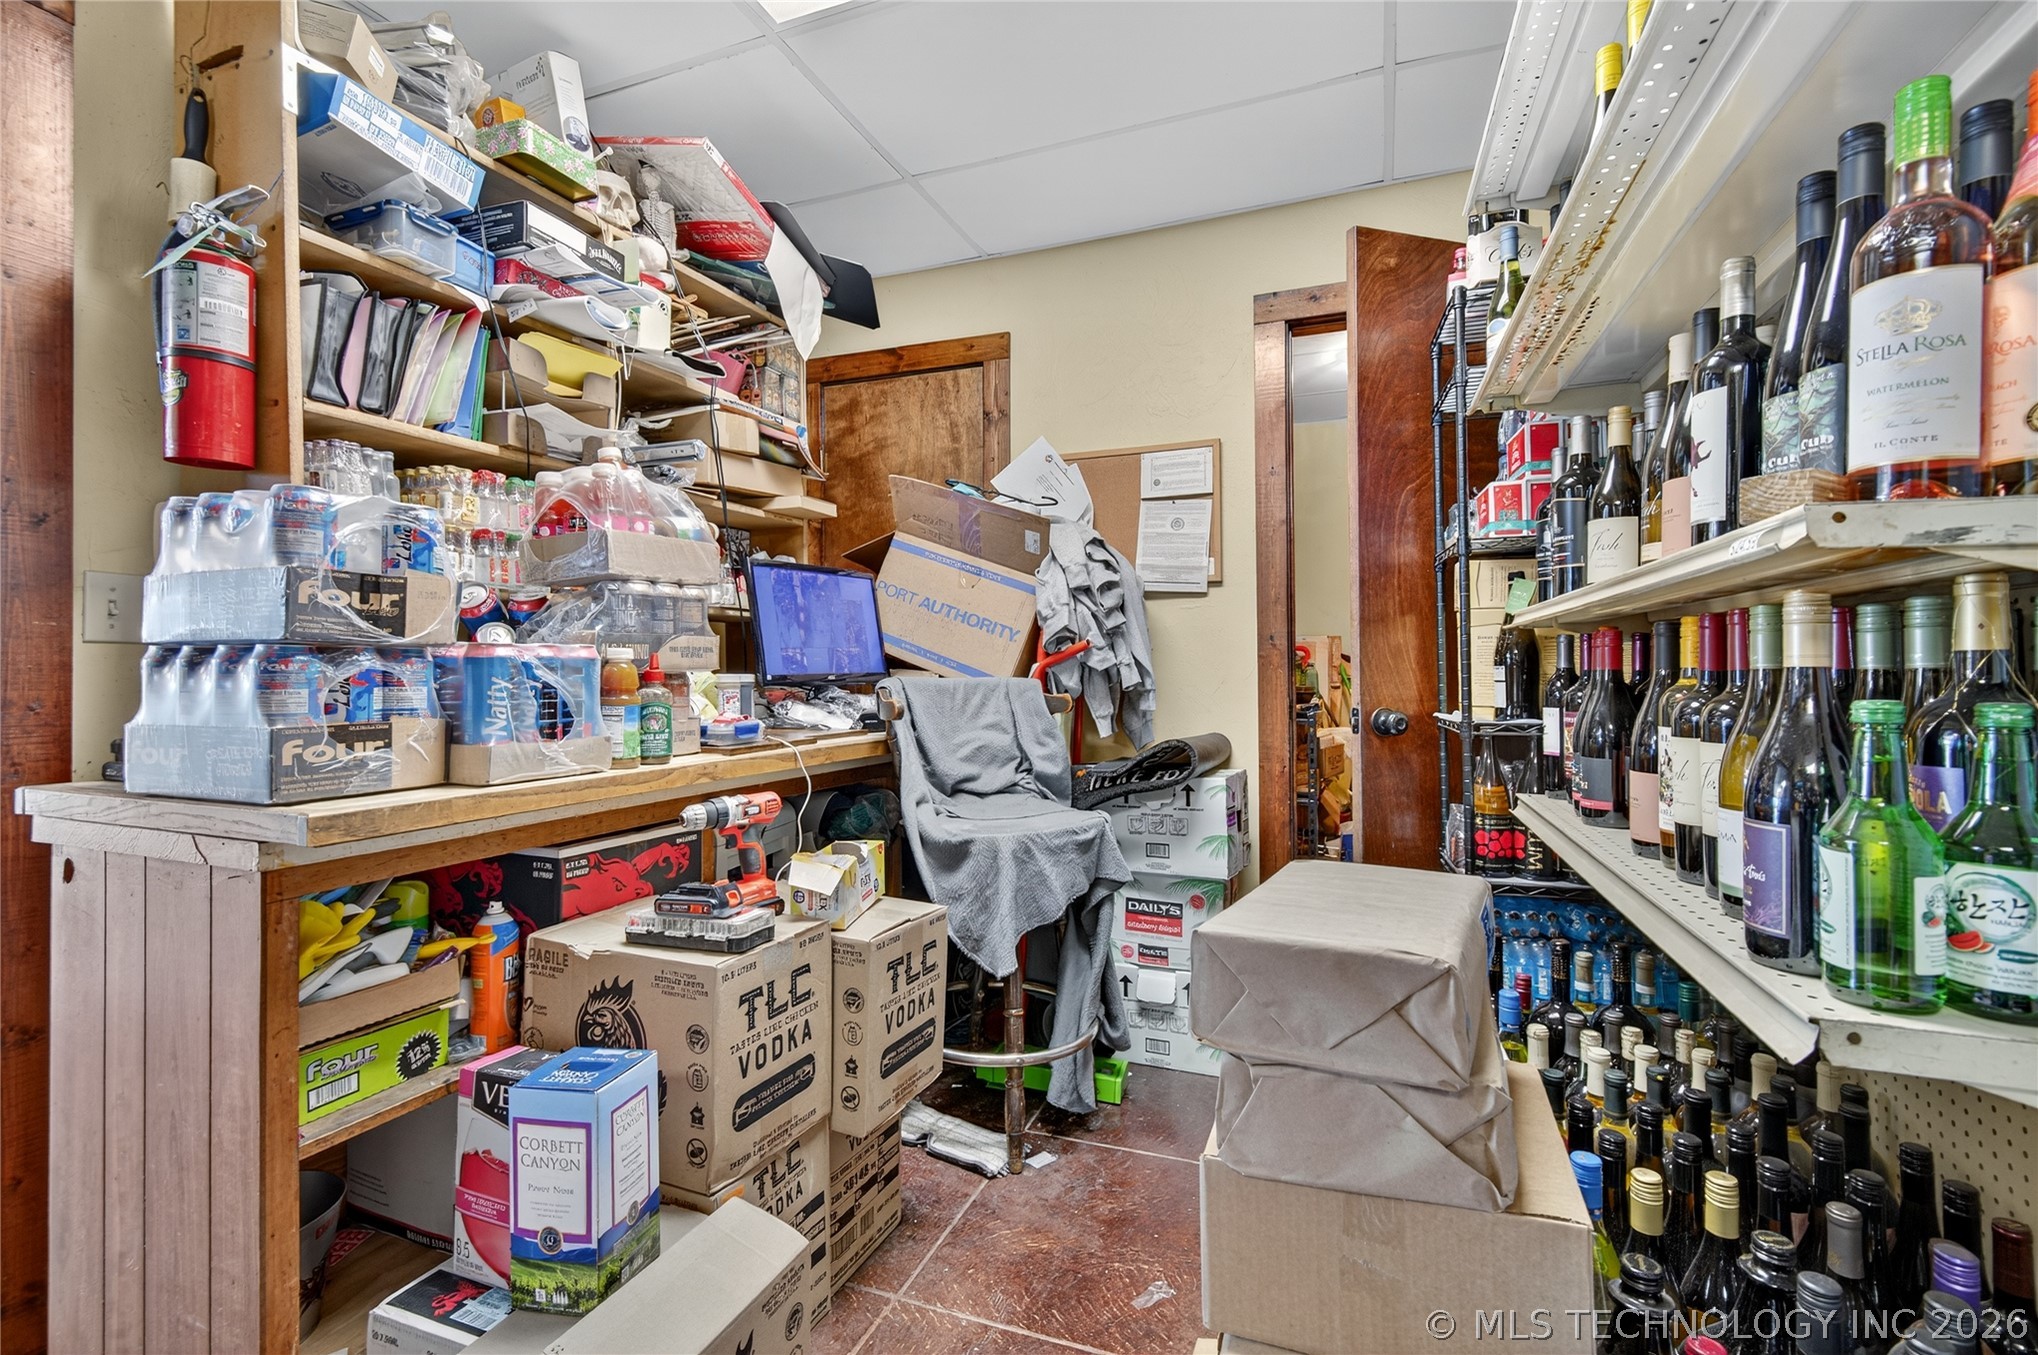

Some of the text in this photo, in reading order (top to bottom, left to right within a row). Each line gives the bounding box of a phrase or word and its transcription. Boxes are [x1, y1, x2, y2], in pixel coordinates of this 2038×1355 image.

[1856, 334, 1967, 367] STELLA ROSA
[1867, 377, 1949, 396] WATERMELON
[1889, 434, 1939, 447] CONTE
[877, 580, 1021, 642] PORT AUTHORITY
[485, 676, 513, 736] Natty
[886, 939, 938, 994] TLC
[738, 962, 811, 1033] TLC
[885, 987, 936, 1035] VODKA
[738, 1018, 812, 1080] VODKA
[519, 1136, 584, 1156] CORBETT
[520, 1153, 580, 1172] CANYON
[753, 1140, 804, 1200] TLC
